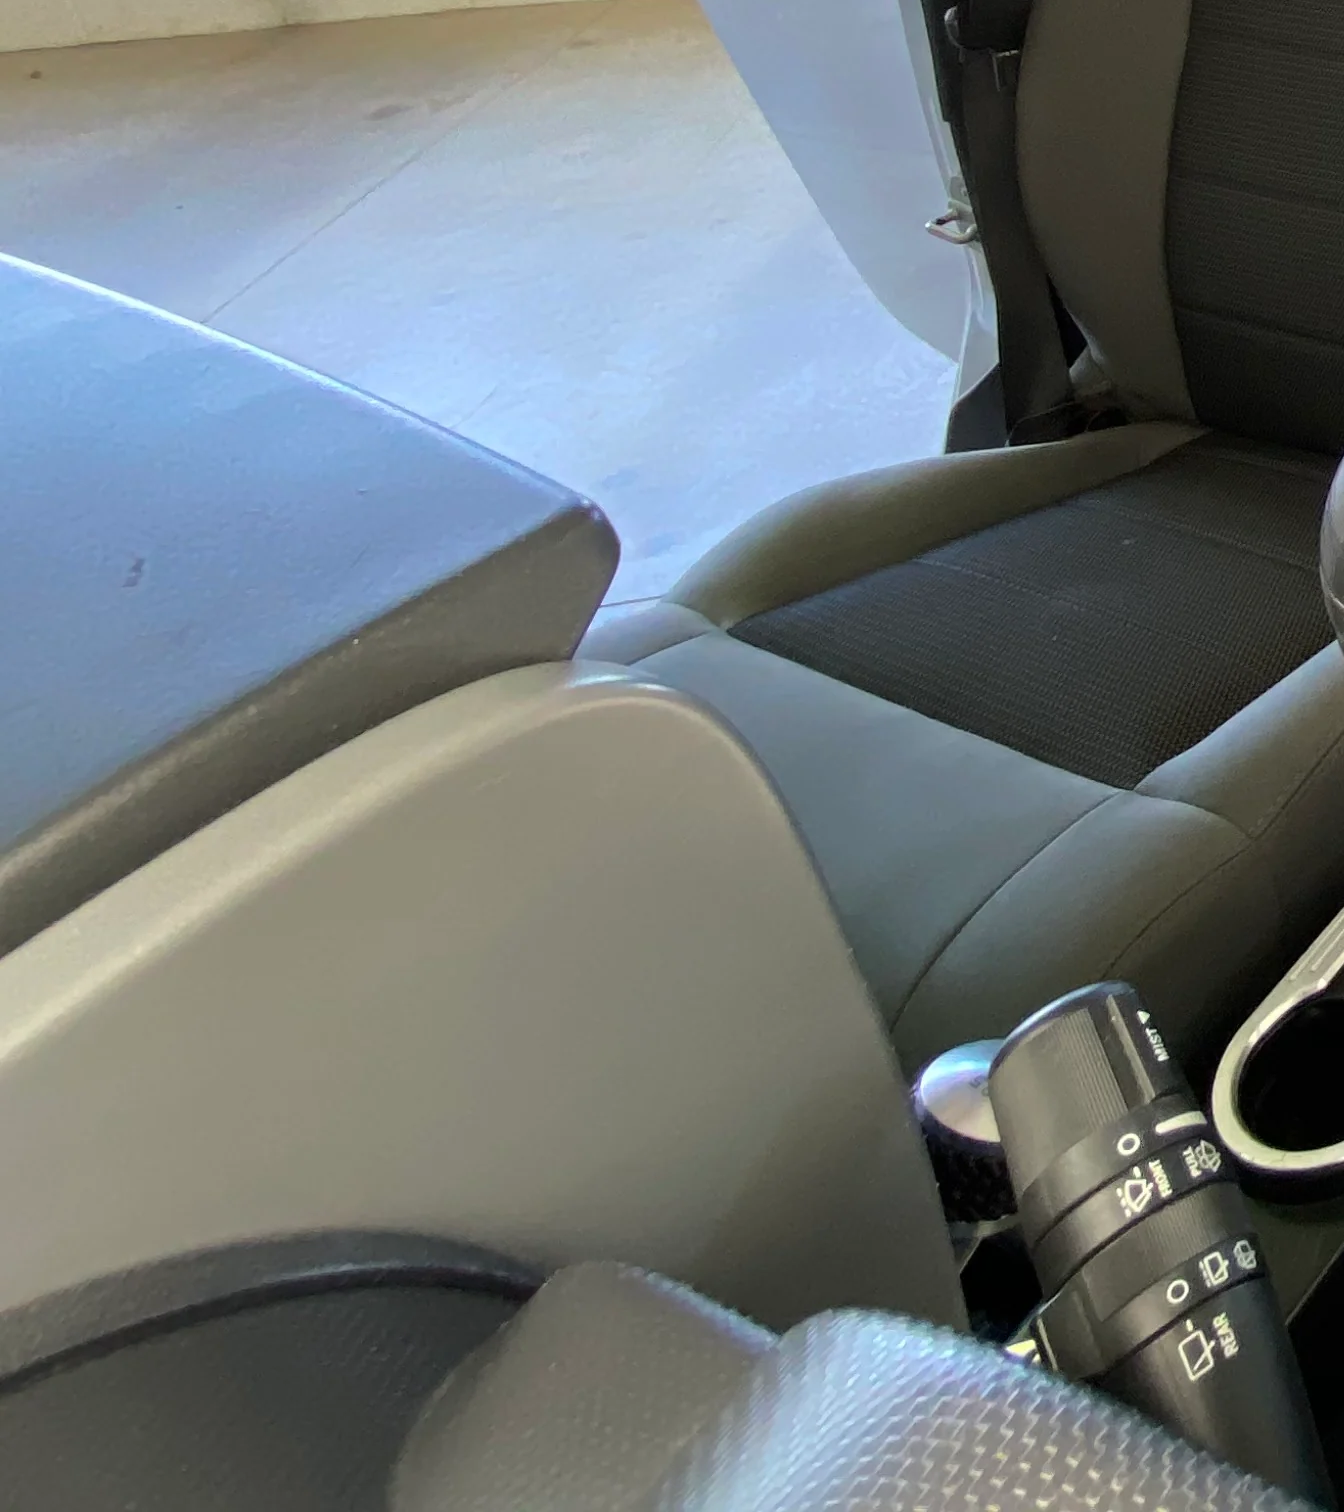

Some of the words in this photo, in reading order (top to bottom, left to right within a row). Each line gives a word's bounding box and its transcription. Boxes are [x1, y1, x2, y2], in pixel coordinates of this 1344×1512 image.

[1145, 1028, 1169, 1061] MIST
[1149, 1159, 1173, 1198] FRONT
[1182, 1145, 1202, 1178] PULL
[1212, 1311, 1240, 1358] REAR
